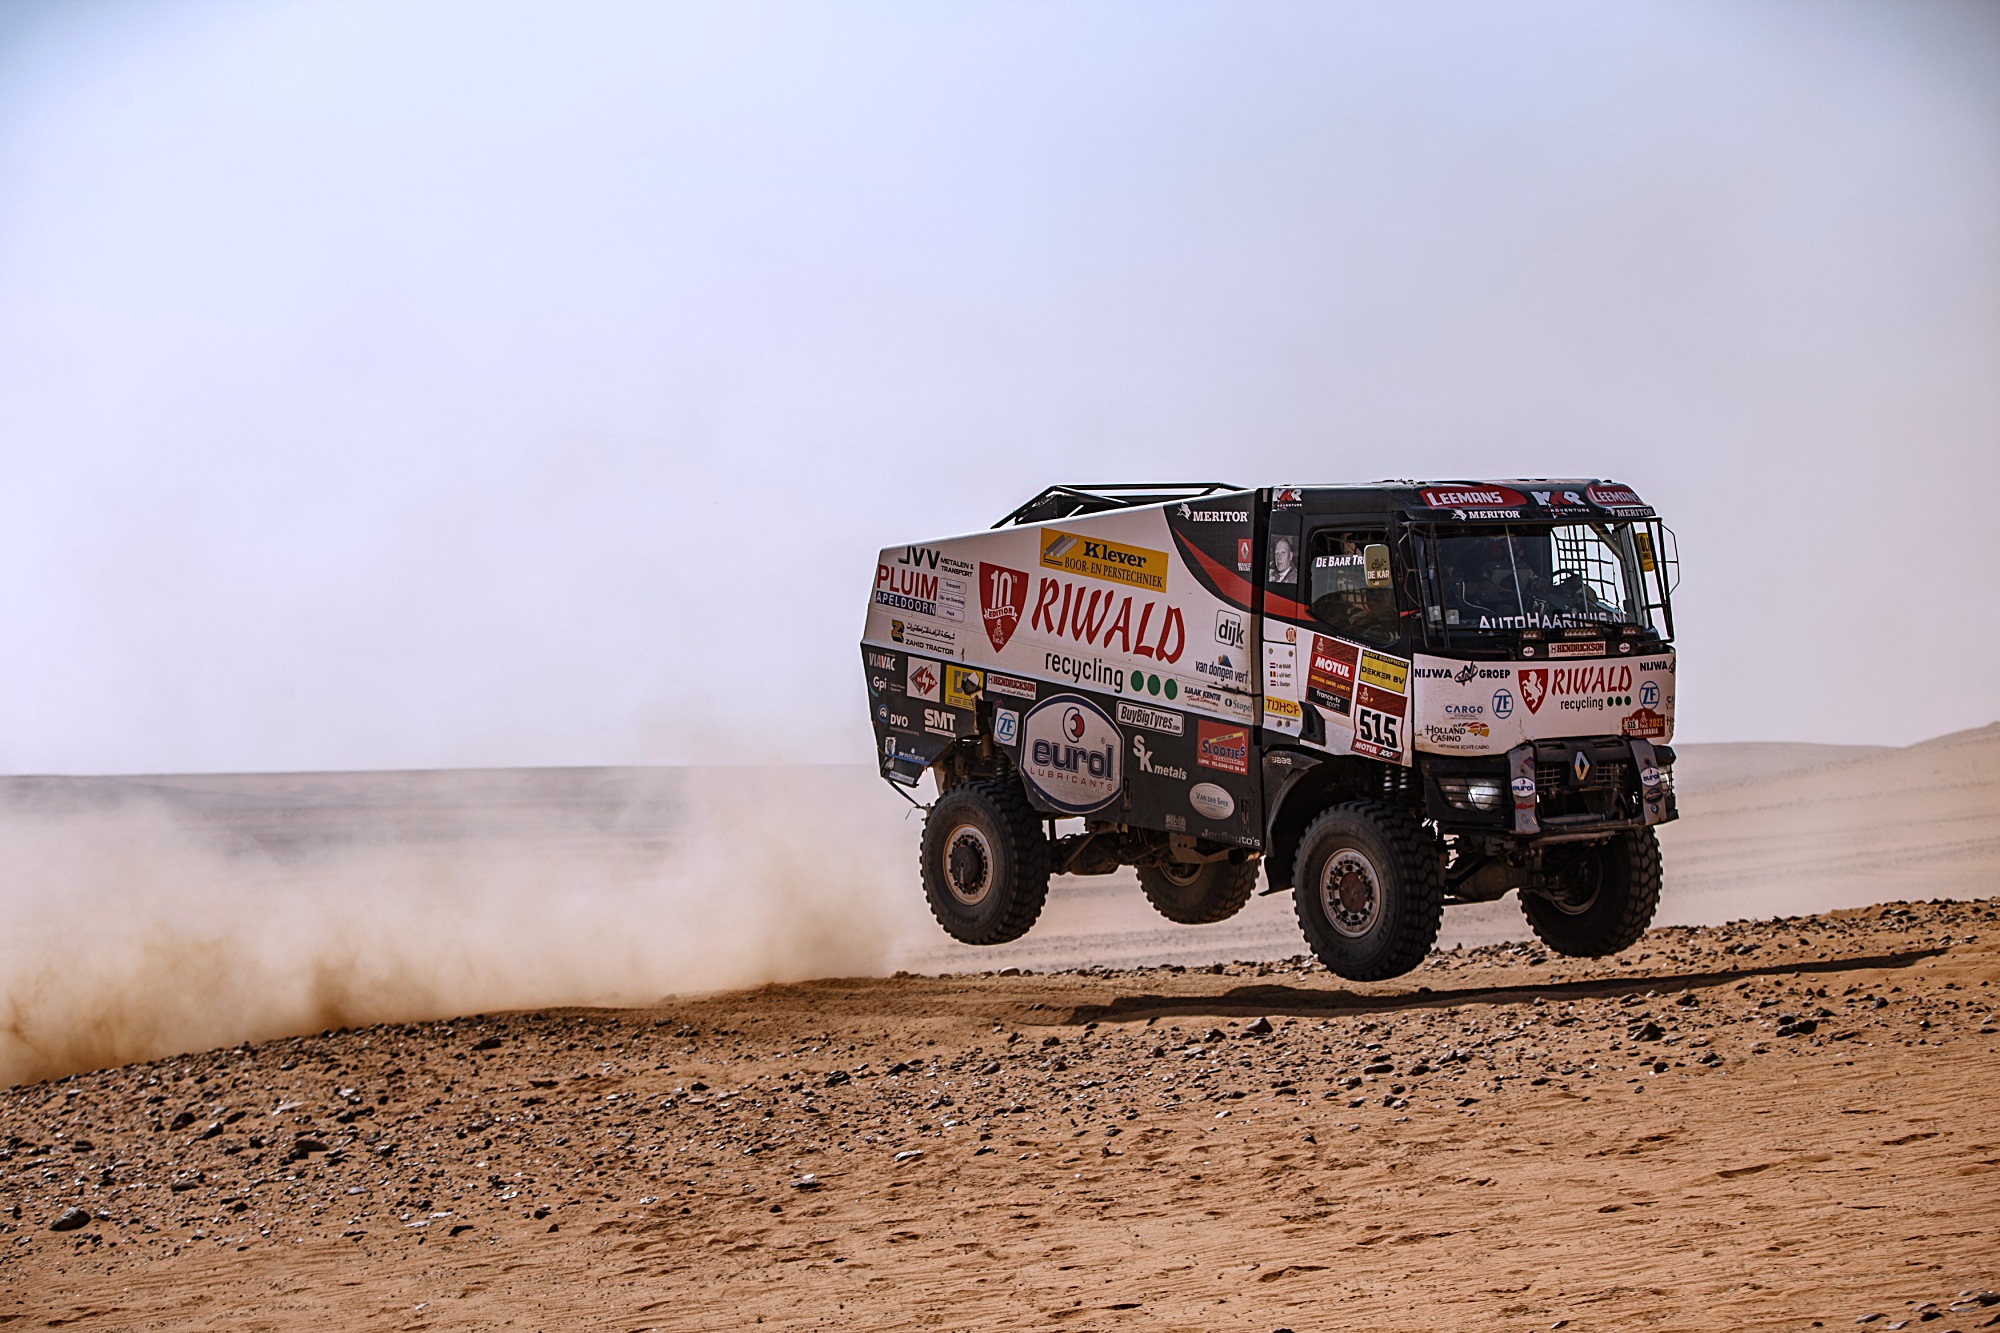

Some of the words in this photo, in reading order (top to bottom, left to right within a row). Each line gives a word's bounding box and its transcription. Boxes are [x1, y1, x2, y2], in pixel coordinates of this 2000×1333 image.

[1426, 490, 1504, 507] LEEMANS
[1192, 511, 1249, 522] MERITOR
[1469, 509, 1521, 520] MERITOR
[1617, 507, 1654, 517] MERITOR
[898, 545, 941, 570] JVV
[1083, 540, 1148, 568] Klever
[940, 557, 969, 570] METALEN
[941, 565, 973, 578] TRANSPORT
[1064, 556, 1089, 572] BOOR-
[1090, 562, 1102, 575] EN
[1103, 565, 1163, 588] PERSTECHNIEK
[1367, 570, 1376, 579] DE
[876, 564, 939, 601] PLUIM
[876, 591, 936, 616] APELDOORN
[988, 607, 1013, 618] EDITION
[1031, 576, 1186, 665] RIWALD
[1218, 619, 1245, 647] dijk
[905, 638, 925, 649] ZAHID
[925, 643, 954, 656] TRACTOR
[1556, 642, 1605, 653] HENDRICKSON
[1045, 652, 1124, 693] recycling
[1195, 660, 1208, 674] van
[1208, 661, 1234, 682] dongen
[1234, 670, 1249, 684] verf
[1314, 656, 1350, 678] MOTUL
[1414, 668, 1453, 679] NIJWA
[1479, 669, 1511, 679] GROEP
[1639, 661, 1668, 672] NIJWA
[873, 676, 887, 691] Gpi
[1361, 666, 1392, 681] DEKKER
[1392, 675, 1405, 685] BV
[1551, 665, 1633, 696] RIWALD
[993, 675, 1036, 693] HENDRICKSON
[1184, 686, 1202, 697] SJAAK
[1202, 690, 1222, 702] KENTIE
[1640, 687, 1659, 705] ZF
[1326, 700, 1340, 710] sport
[1445, 705, 1484, 714] CARGO
[1493, 695, 1513, 713] ZF
[1560, 696, 1604, 712] recycling
[889, 713, 909, 727] DVO
[924, 708, 956, 731] SMT
[999, 718, 1016, 736] ZF
[1627, 721, 1636, 729] 515
[1649, 718, 1664, 728] 2021
[1359, 707, 1398, 749] 515
[1425, 724, 1466, 735] HOLLAND
[1430, 734, 1461, 743] CASINO
[1202, 740, 1246, 759] SLOOTJES
[1354, 742, 1377, 754] MOTUL
[1032, 738, 1114, 781] eurol
[1030, 766, 1113, 792] LUBRICANTS
[1154, 764, 1187, 780] metals
[1642, 773, 1660, 782] eurol
[1512, 783, 1534, 792] eurol
